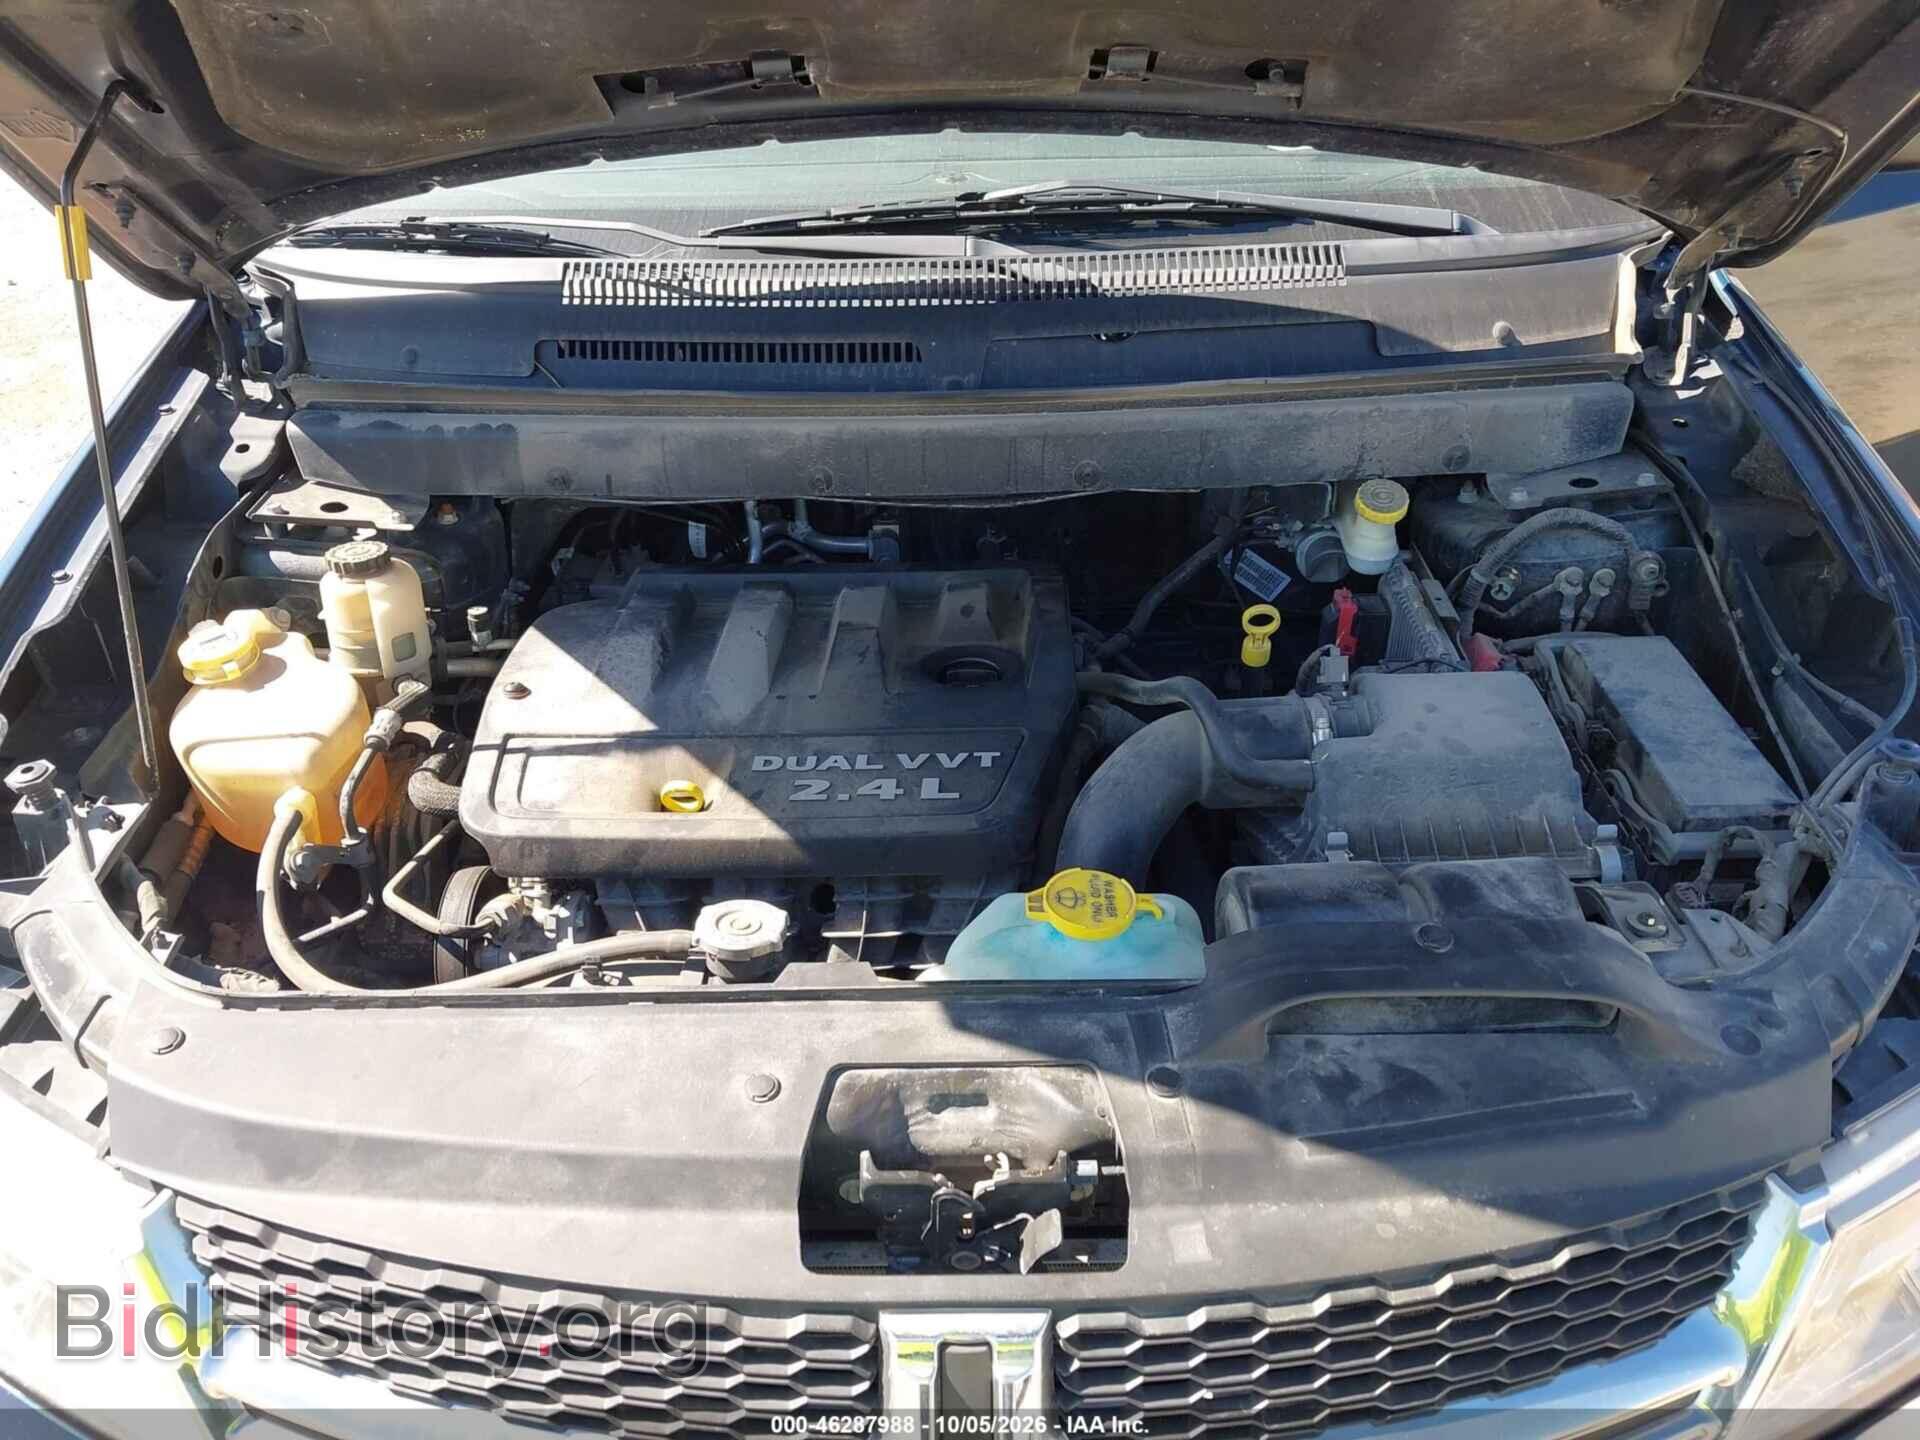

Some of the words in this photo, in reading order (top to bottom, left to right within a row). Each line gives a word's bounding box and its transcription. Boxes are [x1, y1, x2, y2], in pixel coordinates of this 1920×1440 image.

[752, 754, 884, 771] DUAL
[897, 752, 1001, 769] VVT
[789, 778, 904, 801] 2.4
[1104, 880, 1118, 918] WASHER
